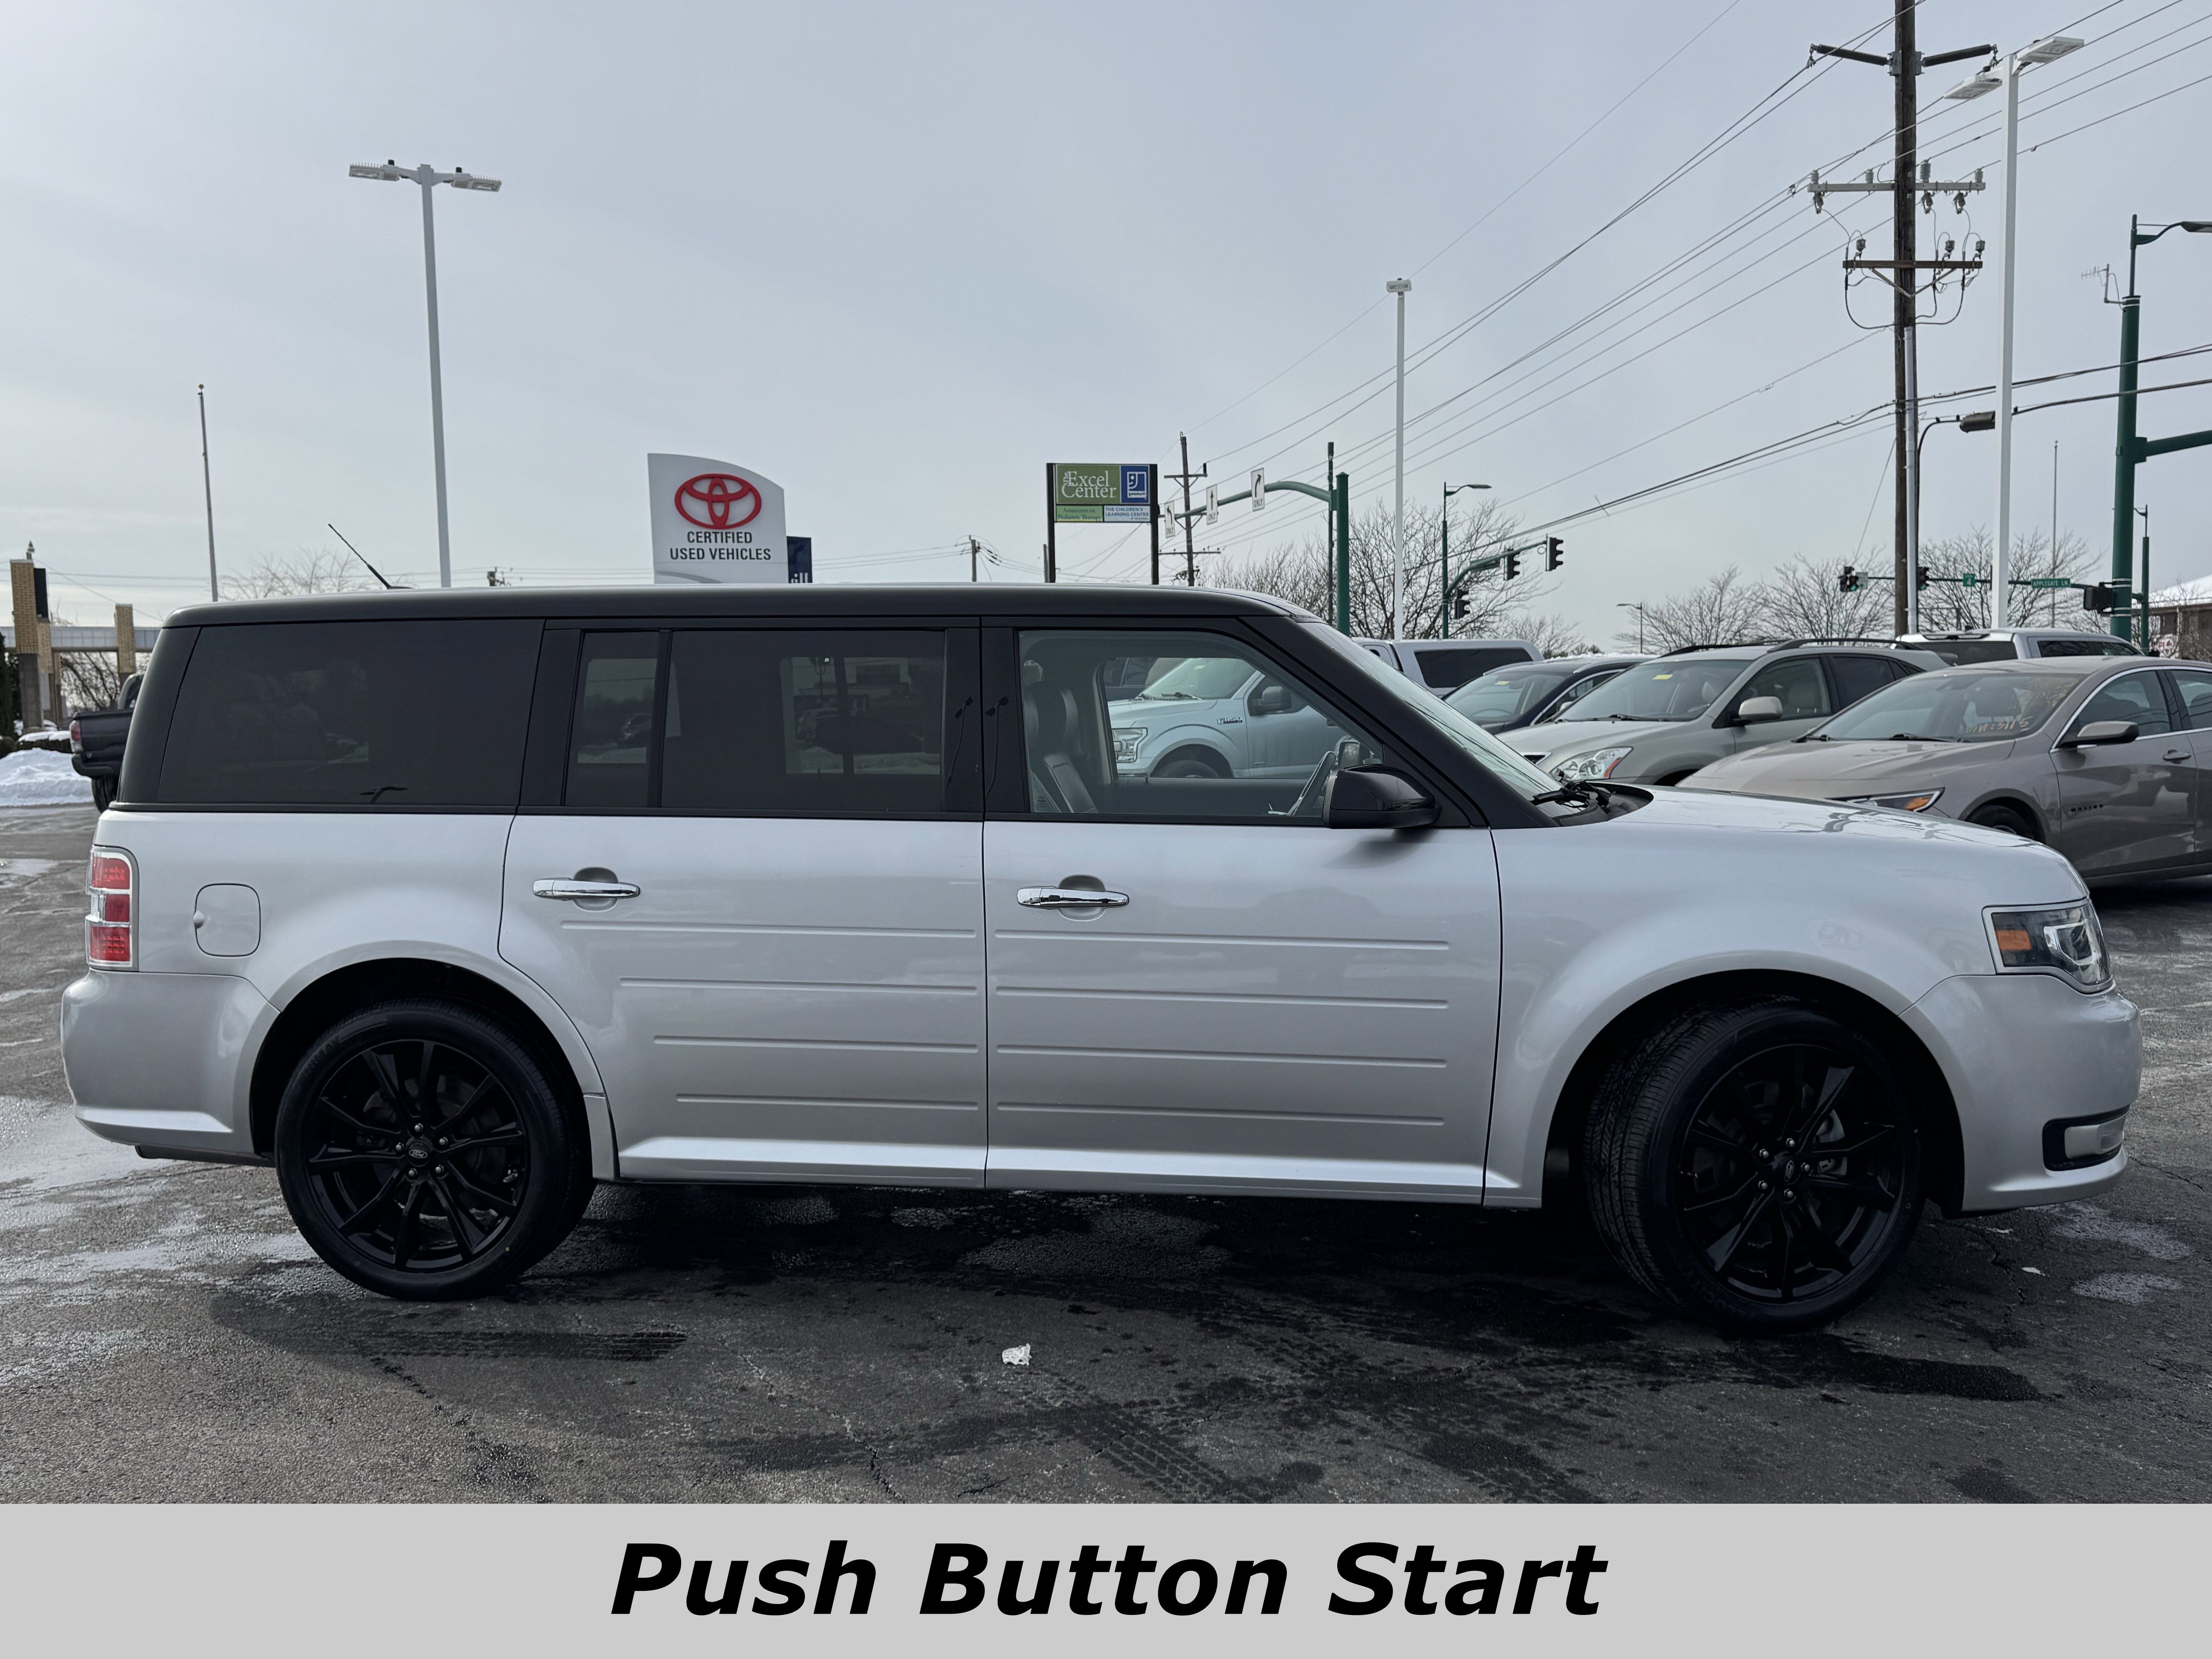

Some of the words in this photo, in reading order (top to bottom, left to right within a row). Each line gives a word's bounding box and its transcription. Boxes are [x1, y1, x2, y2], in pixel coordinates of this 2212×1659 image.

[1067, 471, 1109, 487] Excel
[1061, 483, 1116, 498] Center
[687, 531, 752, 543] CERTIFIED
[670, 548, 704, 560] USED
[709, 548, 771, 560] VEHICLES
